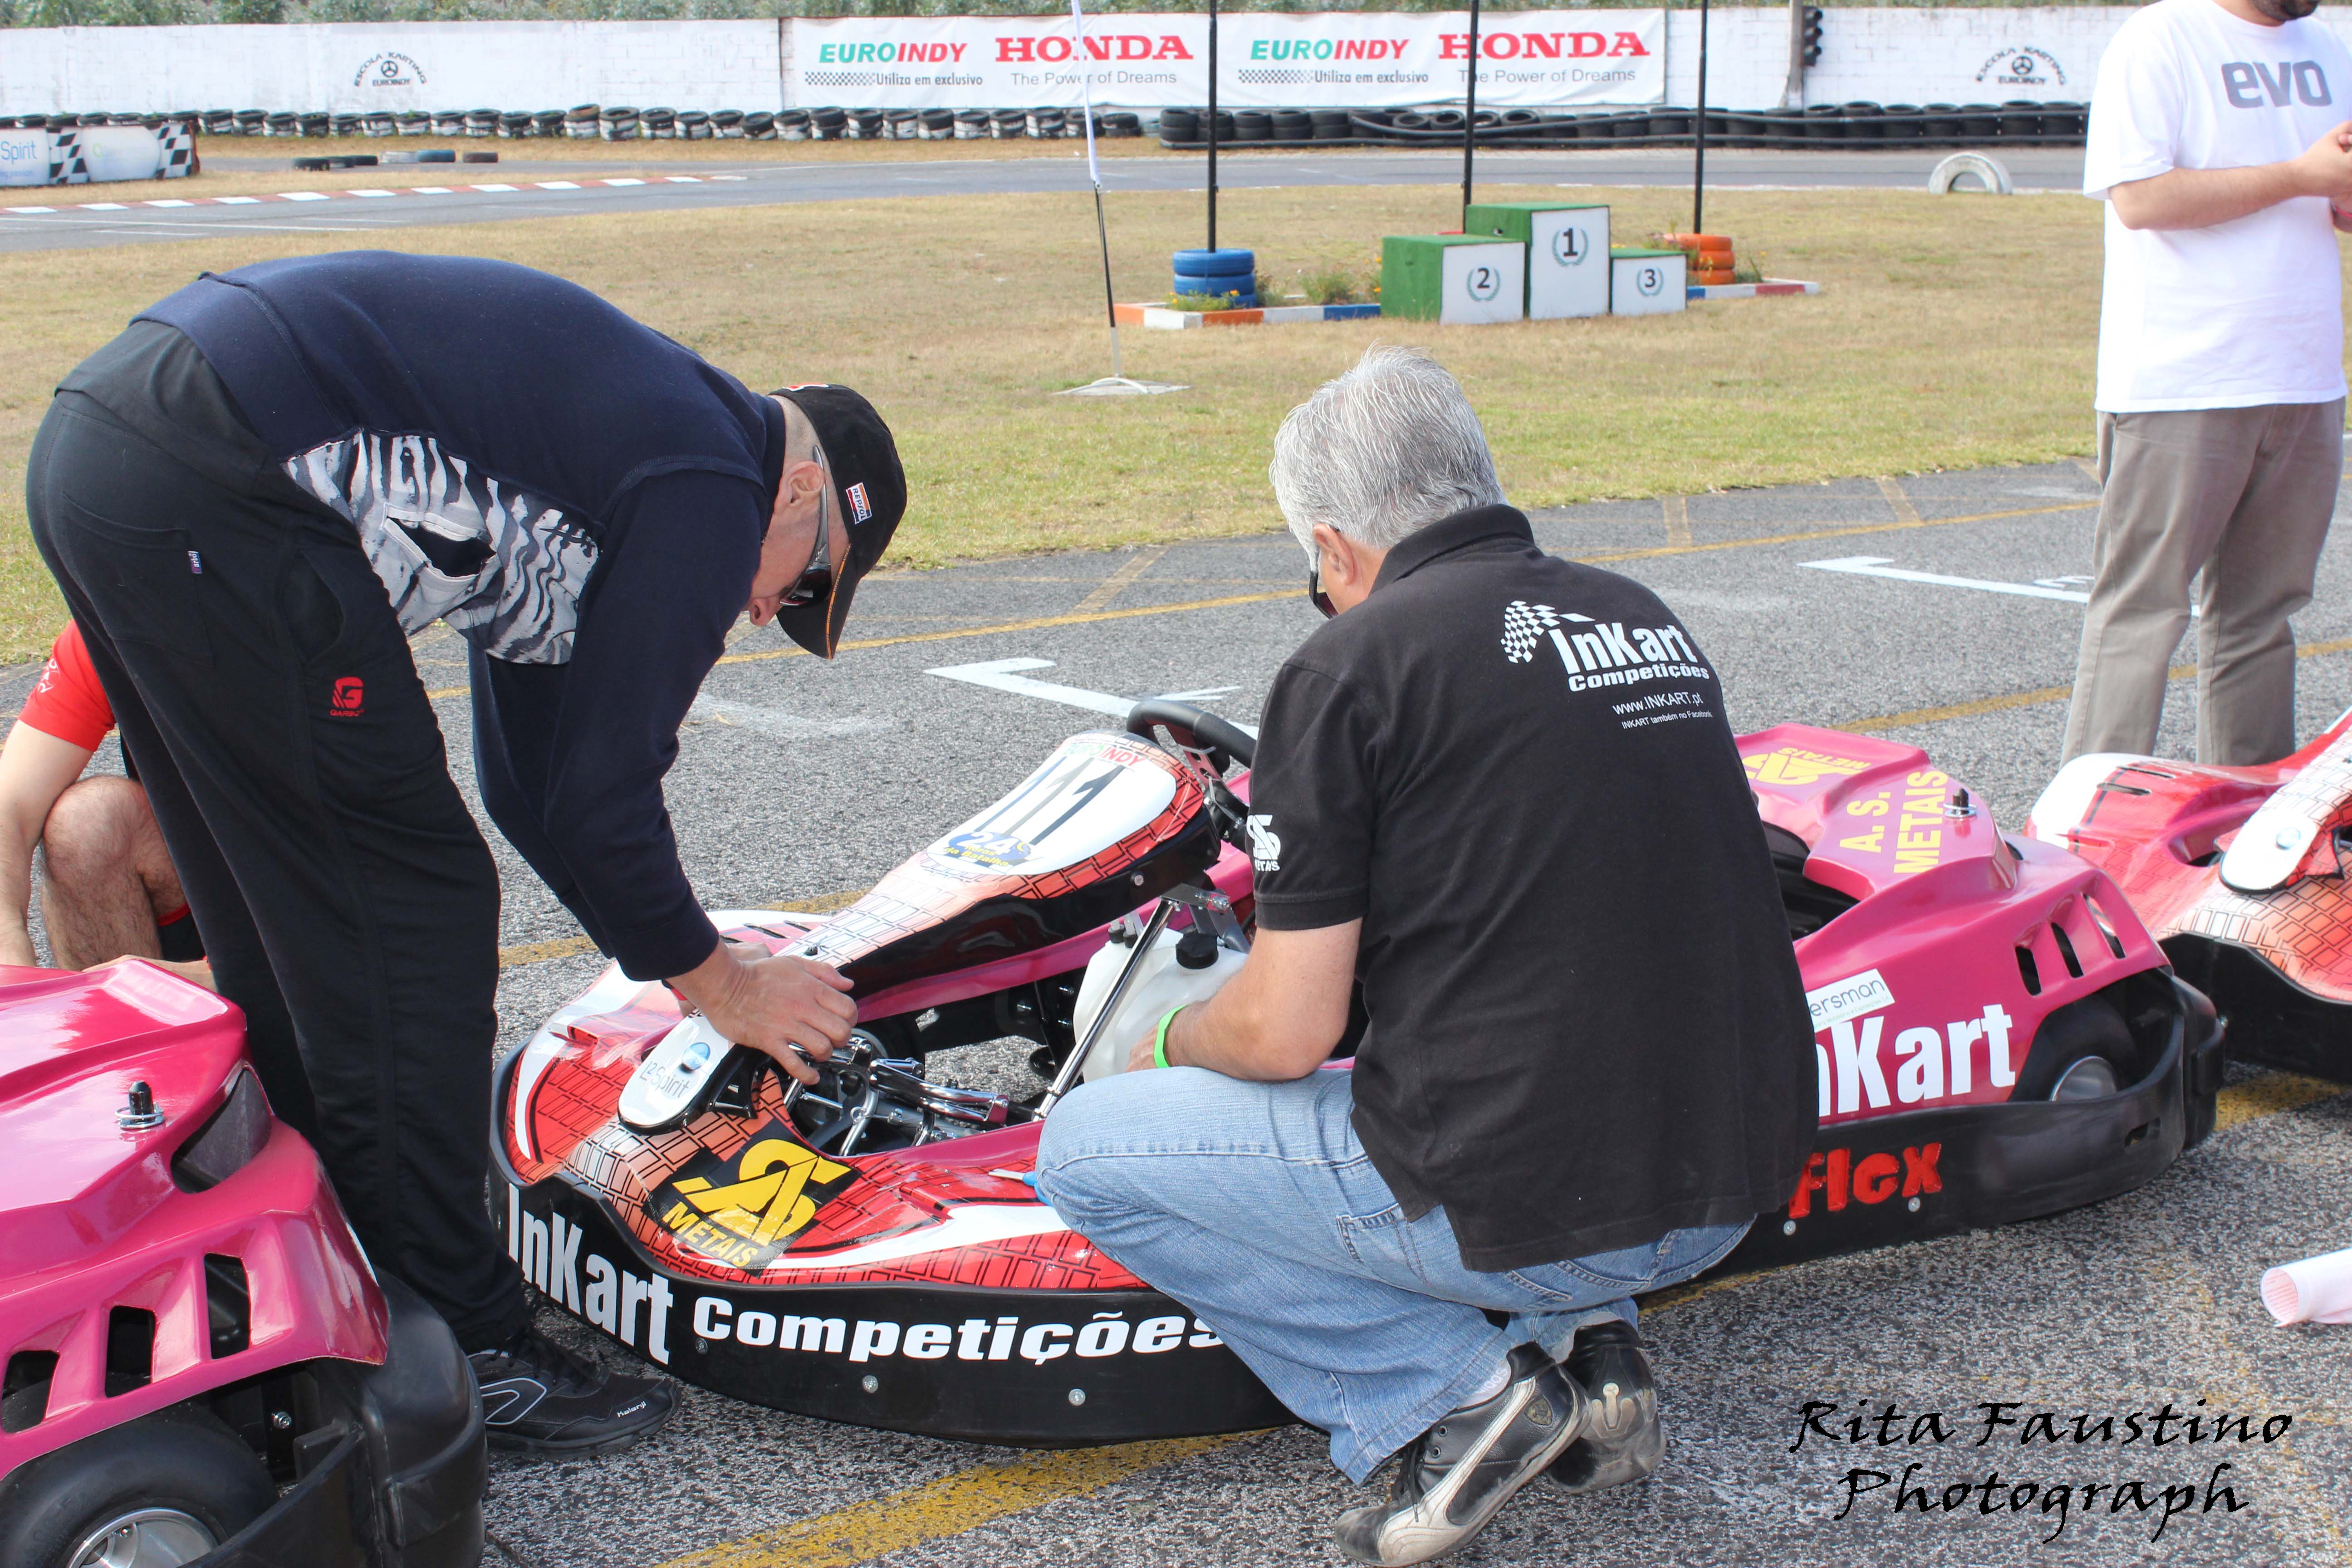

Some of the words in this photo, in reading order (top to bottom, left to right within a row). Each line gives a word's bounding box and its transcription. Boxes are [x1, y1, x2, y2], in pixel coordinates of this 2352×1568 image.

[819, 42, 968, 63] EUROINDY
[995, 35, 1194, 62] HONDA
[1251, 39, 1410, 60] EUROINDY
[1438, 32, 1651, 59] HONDA
[354, 53, 382, 86] ESCOLA
[388, 51, 427, 84] KARTING
[876, 73, 910, 86] Utiliza
[915, 76, 931, 85] em
[935, 73, 983, 85] exclusivo
[1011, 73, 1039, 85] The
[1098, 71, 1112, 83] of
[1117, 71, 1177, 83] Dreams
[1315, 70, 1351, 83] Utiliza
[1356, 73, 1372, 83] em
[1377, 70, 1429, 83] exclusivo
[1495, 70, 1545, 82] Power
[1551, 69, 1566, 82] of
[1572, 69, 1636, 82] Dreams
[2221, 60, 2332, 109] evo
[0, 140, 36, 164] Spirit
[1563, 228, 1578, 257] 1
[1477, 268, 1490, 289] 2
[1645, 270, 1656, 288] 3
[853, 488, 866, 520] REPSOL
[1568, 663, 1709, 692] Competições
[1612, 691, 1704, 715] www.INKART.pt
[1622, 717, 1650, 730] INKART
[1650, 713, 1678, 724] também
[1778, 747, 1871, 769] METAIS
[1846, 791, 1891, 817] S.
[1894, 771, 1949, 873] METAIS
[956, 831, 1020, 855] 24
[965, 844, 996, 856] horas
[1839, 826, 1885, 853] A.
[960, 850, 1009, 867] Batalha
[662, 1202, 758, 1267] METAIS
[509, 1183, 673, 1364] InKart
